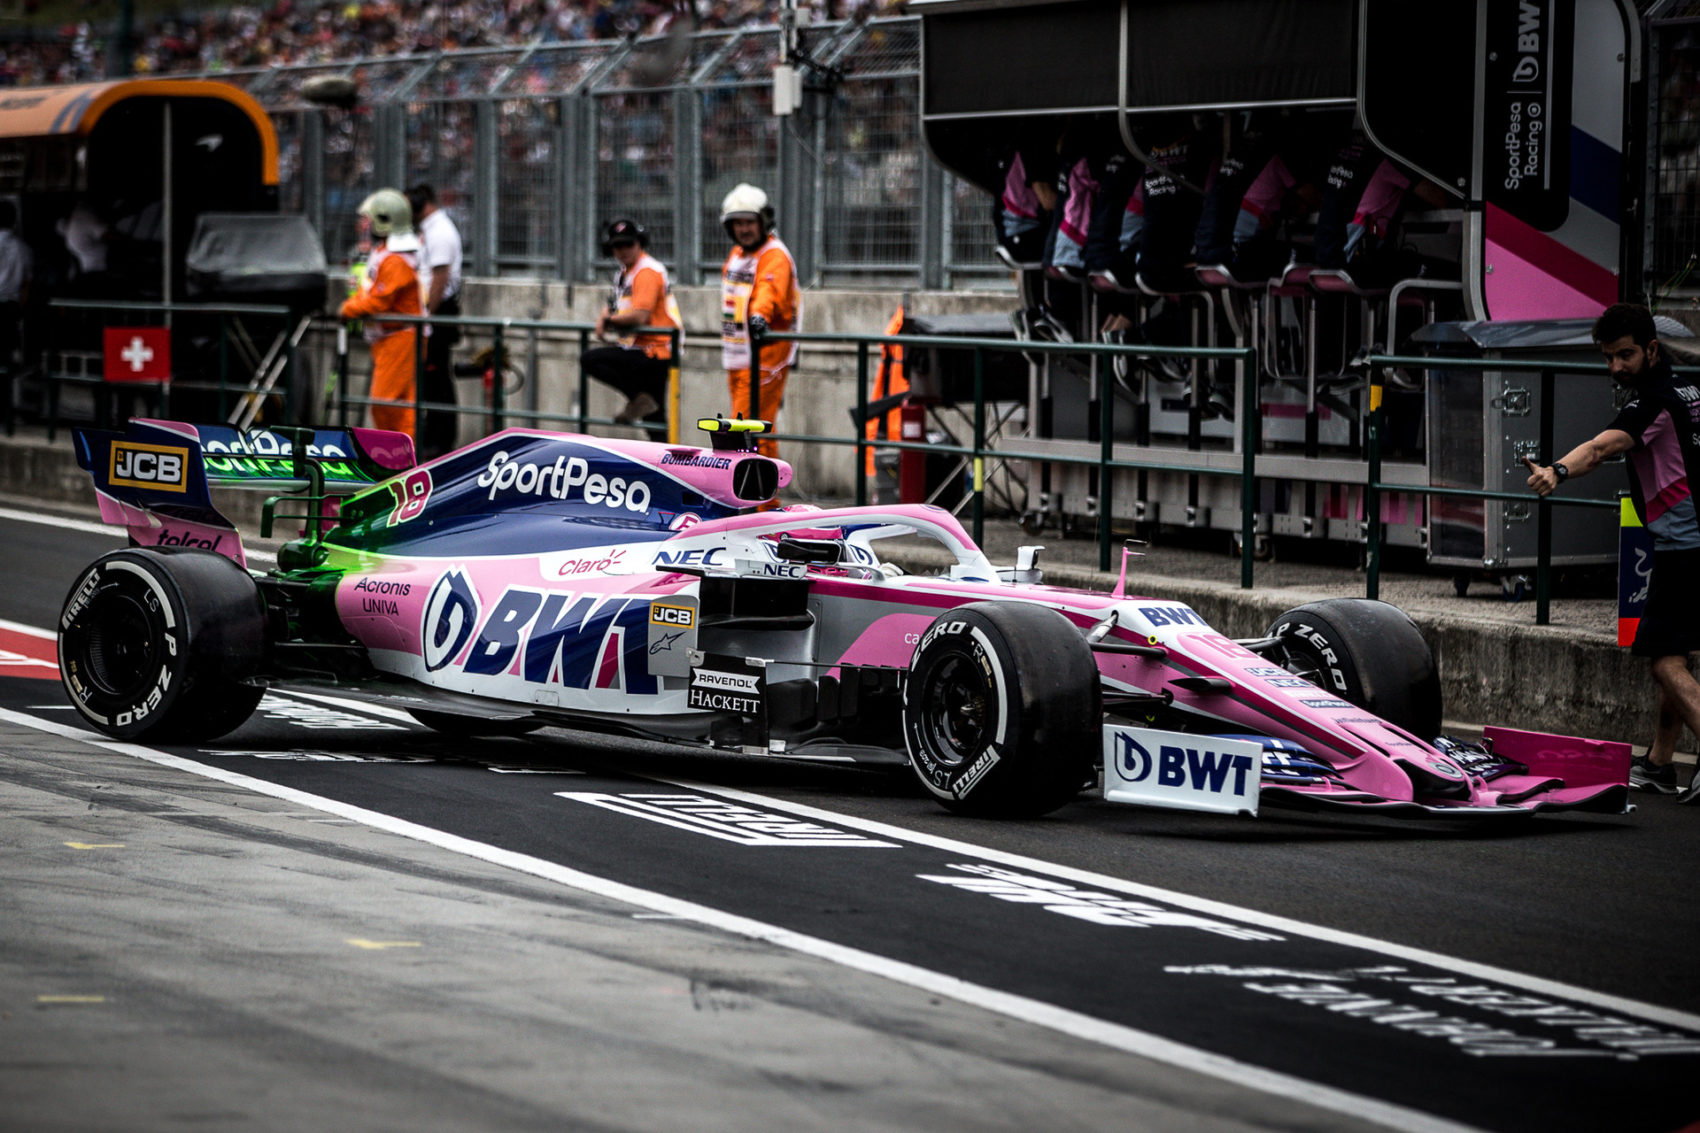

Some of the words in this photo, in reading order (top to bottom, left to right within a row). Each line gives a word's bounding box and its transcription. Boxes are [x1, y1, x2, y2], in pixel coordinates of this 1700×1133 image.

[1518, 0, 1540, 52] BW
[1504, 102, 1523, 190] SportPesa
[1524, 121, 1543, 176] Racing
[116, 450, 182, 483] JCB
[477, 451, 650, 513] SportPesa
[660, 453, 732, 470] BOMBARDIER
[387, 468, 433, 528] 18
[558, 556, 613, 577] Claro
[652, 547, 727, 566] NEC
[763, 564, 801, 579] NEC
[61, 567, 102, 631] PIRELLI
[354, 577, 412, 597] Acronis
[362, 598, 400, 617] UNIVA
[653, 609, 691, 626] JCB
[1138, 606, 1208, 628] BWT
[164, 632, 178, 657] P
[462, 588, 659, 695] BWT
[911, 620, 967, 673] ZERO
[1293, 623, 1348, 691] ZERO
[116, 664, 173, 728] ZERO
[690, 690, 761, 714] HACKETT
[698, 673, 753, 689] RAVENOL
[951, 743, 1002, 801] PIRELLI
[1157, 744, 1254, 797] BWT
